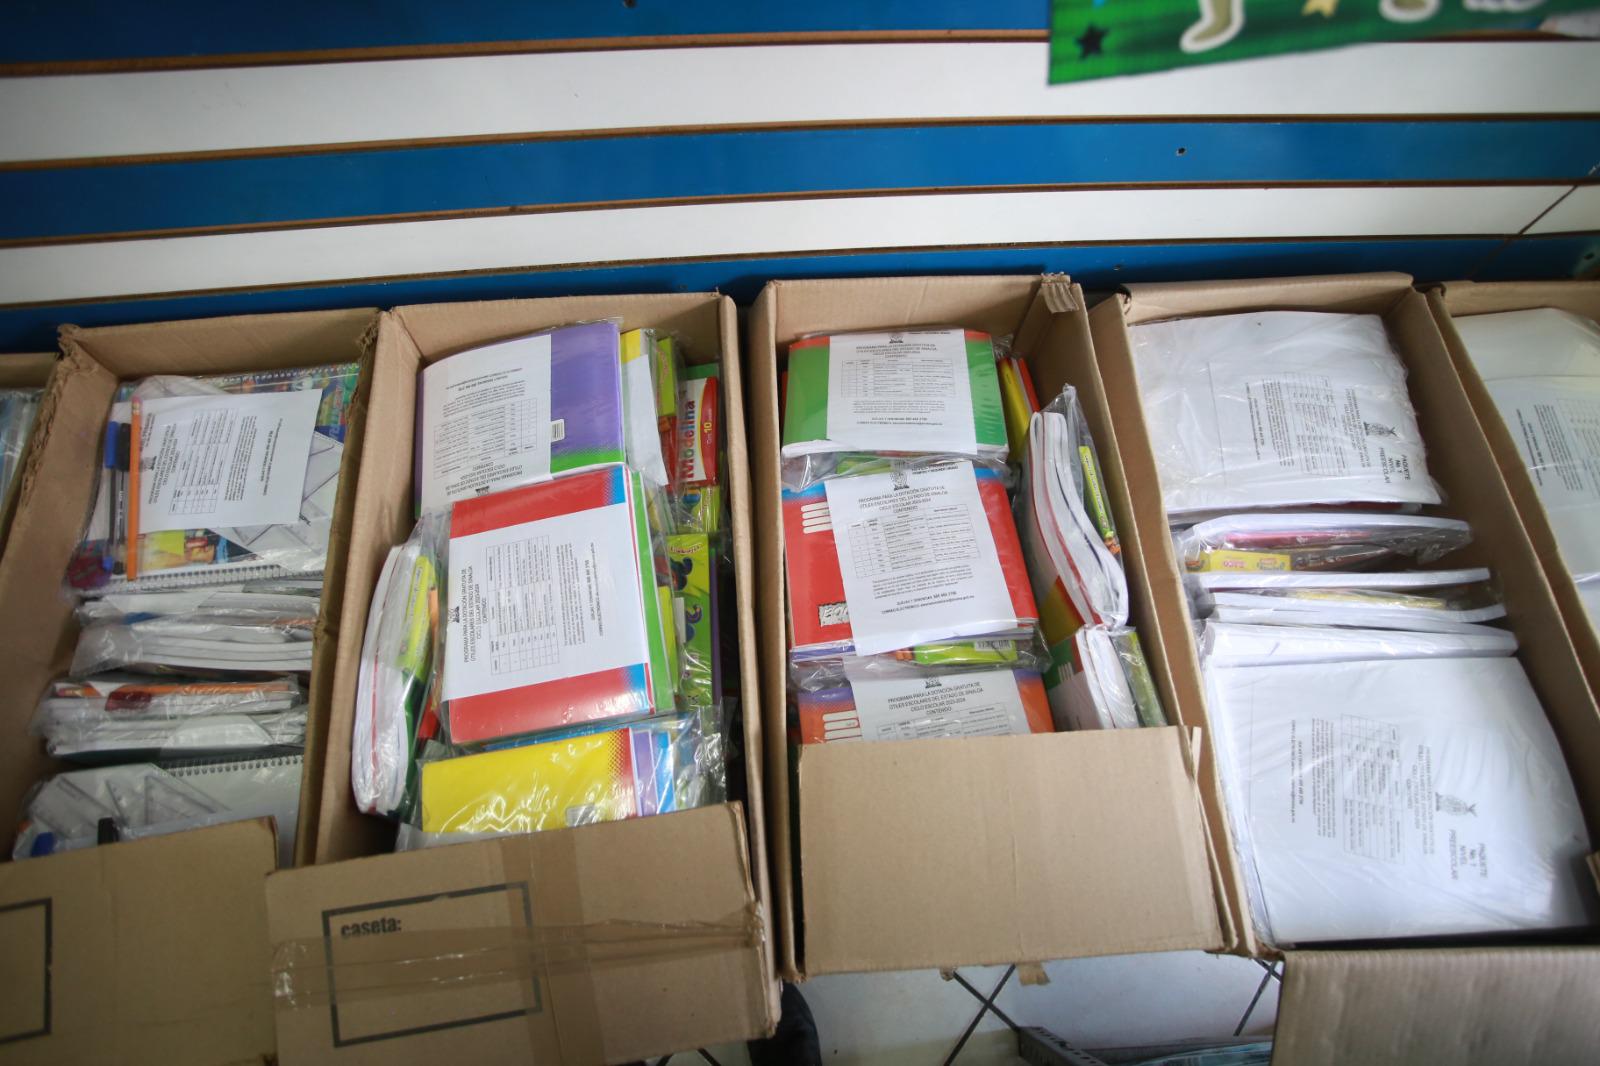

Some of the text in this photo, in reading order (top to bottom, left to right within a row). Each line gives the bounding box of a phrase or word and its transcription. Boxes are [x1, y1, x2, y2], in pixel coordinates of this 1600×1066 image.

[704, 422, 712, 434] 10
[680, 401, 695, 479] Modelina
[341, 916, 402, 936] caseta:
